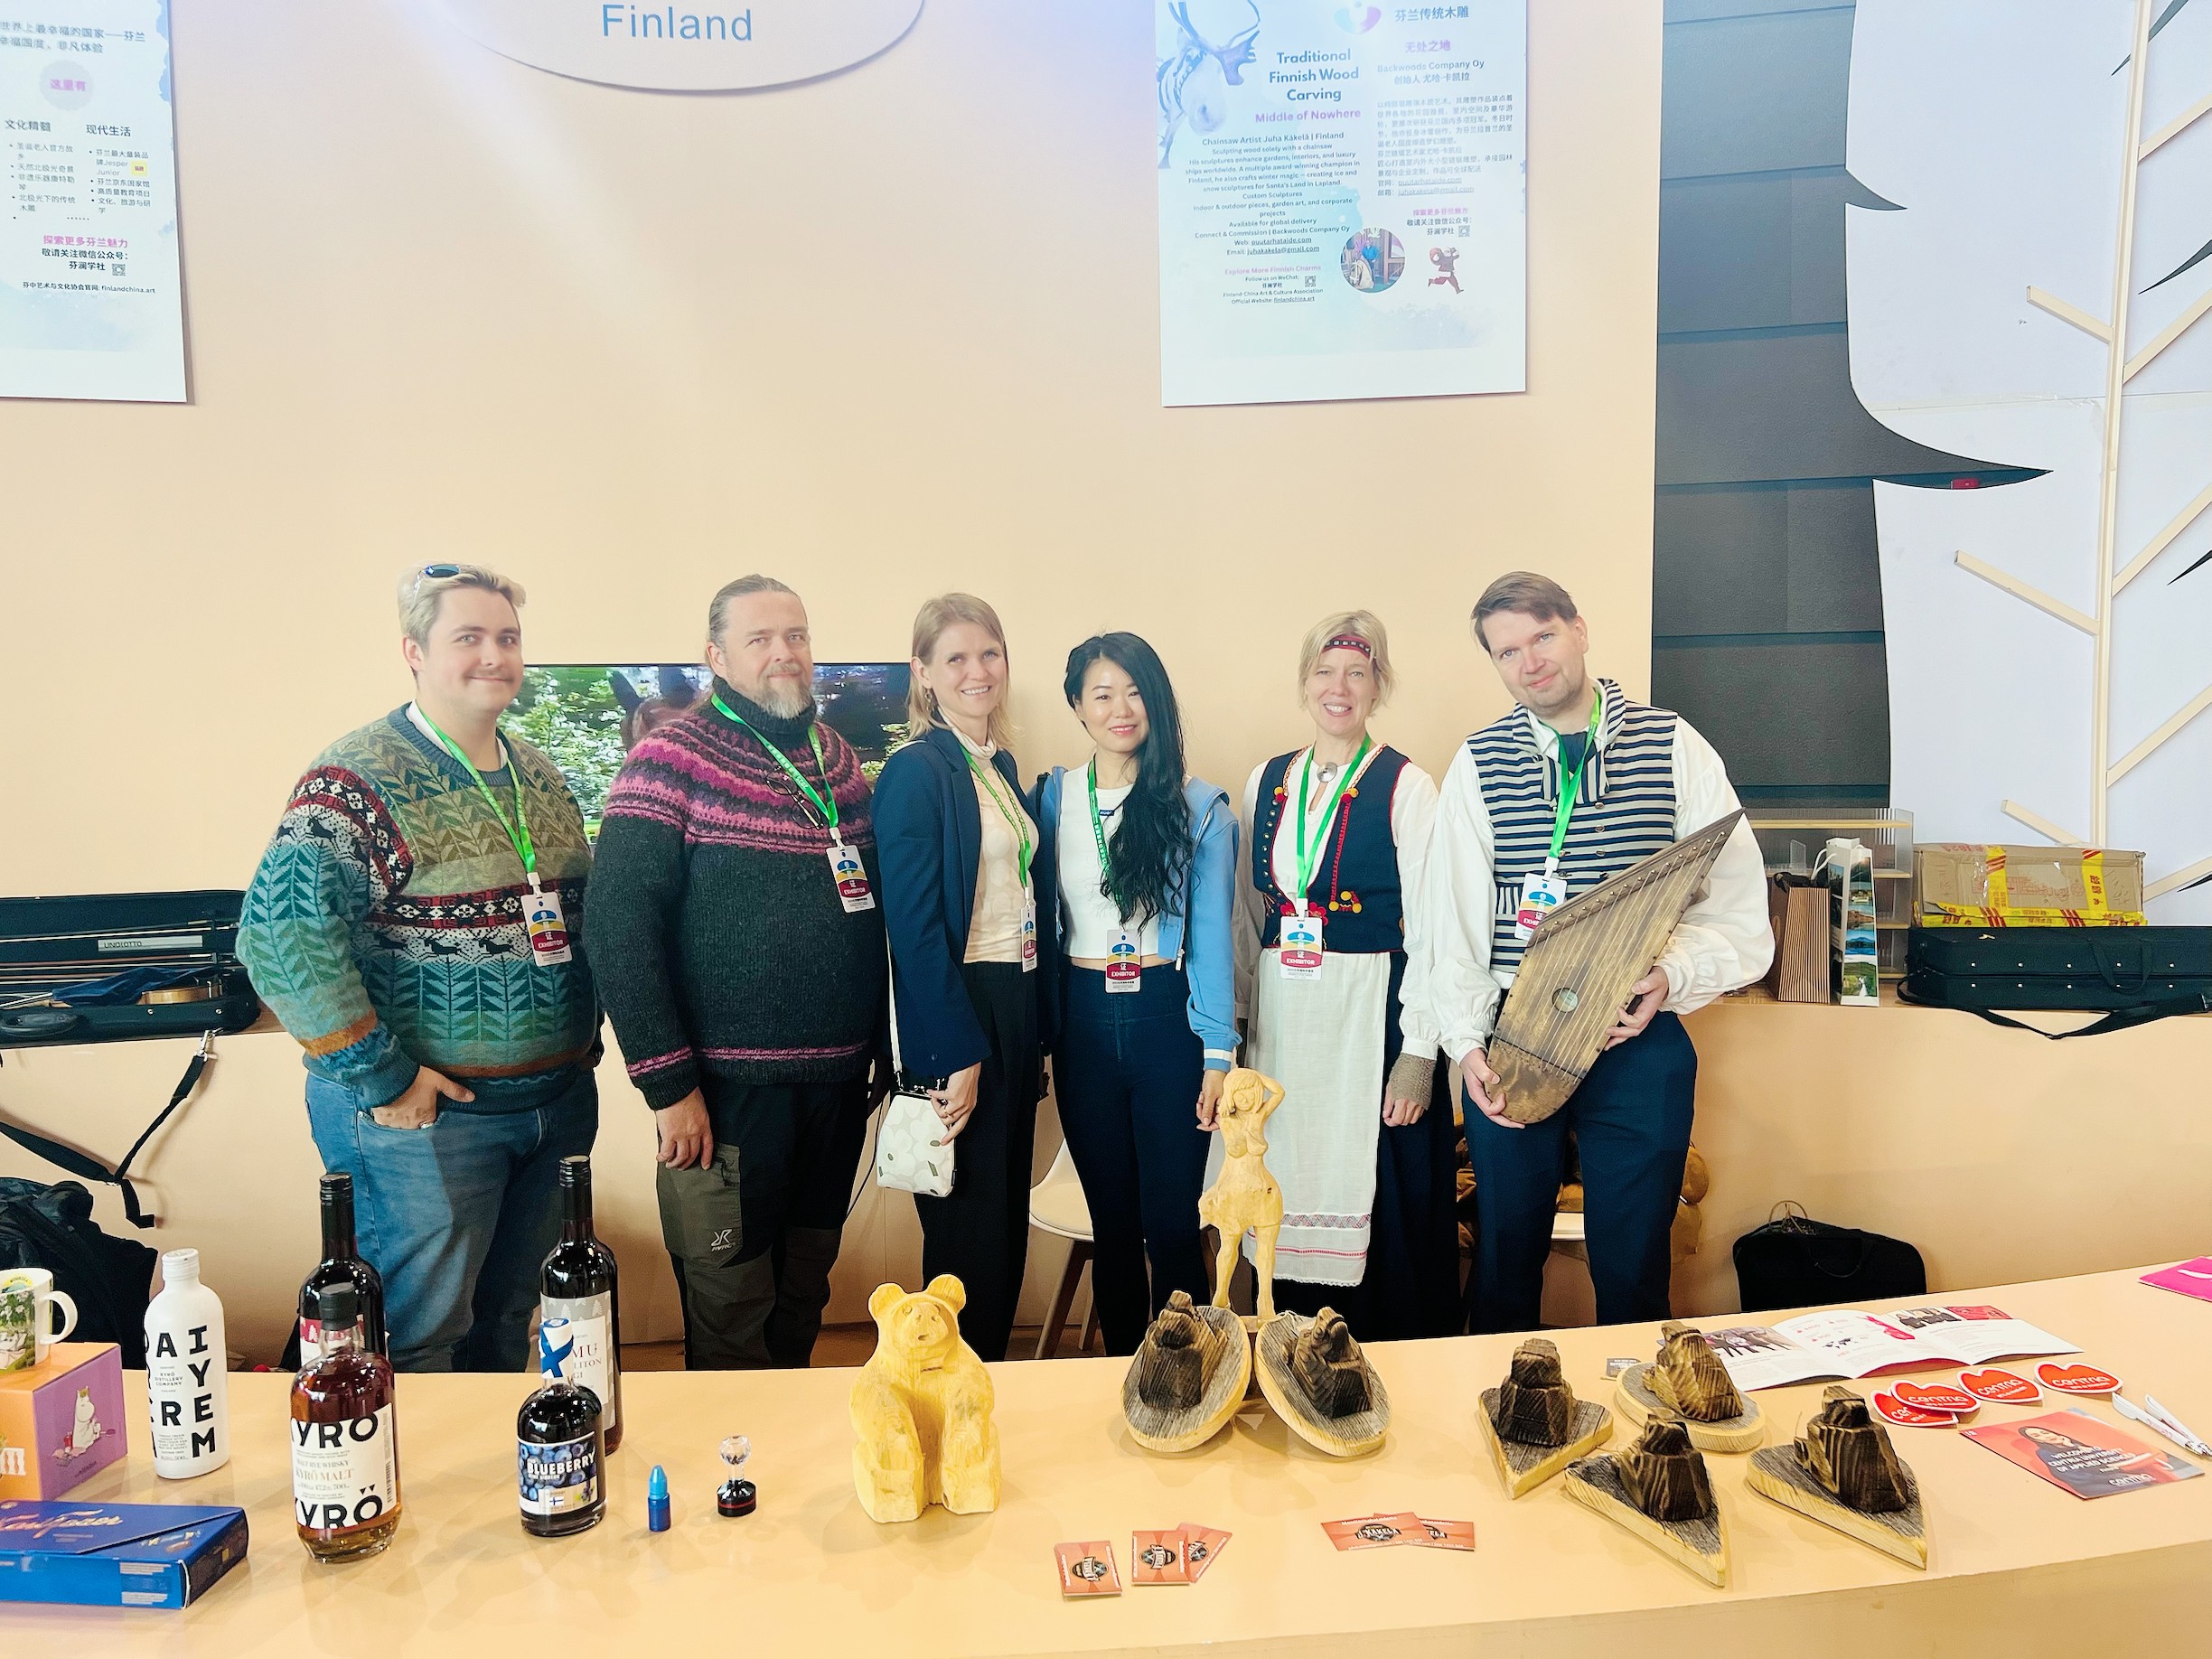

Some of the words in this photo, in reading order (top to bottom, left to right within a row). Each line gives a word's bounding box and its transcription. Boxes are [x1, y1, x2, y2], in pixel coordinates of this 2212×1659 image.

[1395, 5, 1470, 23] 芬兰传统木雕
[602, 4, 752, 42] Finland
[1405, 39, 1451, 54] 无处之地
[1276, 47, 1351, 64] Traditional
[1377, 62, 1427, 73] Backwoods
[1428, 60, 1470, 70] Company
[1472, 59, 1485, 70] Oy
[1269, 69, 1317, 83] Finnish
[1318, 66, 1359, 80] Wood
[50, 79, 87, 91] 这里有
[1286, 88, 1342, 102] Carving
[1255, 111, 1294, 123] Middle
[1296, 110, 1308, 120] of
[1310, 108, 1362, 120] Nowhere
[5, 119, 52, 132] 文化精髓
[86, 124, 132, 137] 现代生活
[1202, 137, 1238, 145] Chainsaw
[1240, 136, 1261, 144] Artist
[1263, 135, 1282, 143] Juha
[1315, 132, 1345, 140] Finland
[1212, 147, 1242, 155] Sculpting
[1262, 145, 1281, 153] solely
[1200, 157, 1234, 165] sculptures
[1263, 155, 1291, 163] gardens,
[1336, 151, 1356, 159] luxury
[1245, 164, 1271, 173] multiple
[1320, 160, 1352, 169] champion
[1238, 173, 1258, 182] crafts
[1258, 173, 1279, 181] winter
[1279, 172, 1299, 181] magic
[1307, 170, 1334, 179] creating
[98, 187, 151, 197] 高质量教育项目
[1221, 184, 1254, 192] sculptures
[1266, 182, 1289, 190] Santa's
[19, 194, 76, 204] 北极光下的传统
[1271, 200, 1294, 209] garden
[1321, 197, 1353, 206] corporate
[1229, 220, 1259, 228] Available
[1270, 218, 1290, 227] global
[1290, 217, 1317, 226] delivery
[1228, 230, 1268, 238] Commission
[1272, 227, 1308, 235] Backwoods
[1308, 225, 1340, 234] Company
[43, 234, 128, 249] 探索更多芬兰魅力
[1224, 267, 1251, 276] Explore
[1270, 266, 1294, 274] Finnish
[1295, 264, 1322, 273] Charms
[1273, 288, 1292, 296] Culture
[527, 1449, 595, 1475] BLUEBERRY
[320, 1467, 354, 1482] MALT
